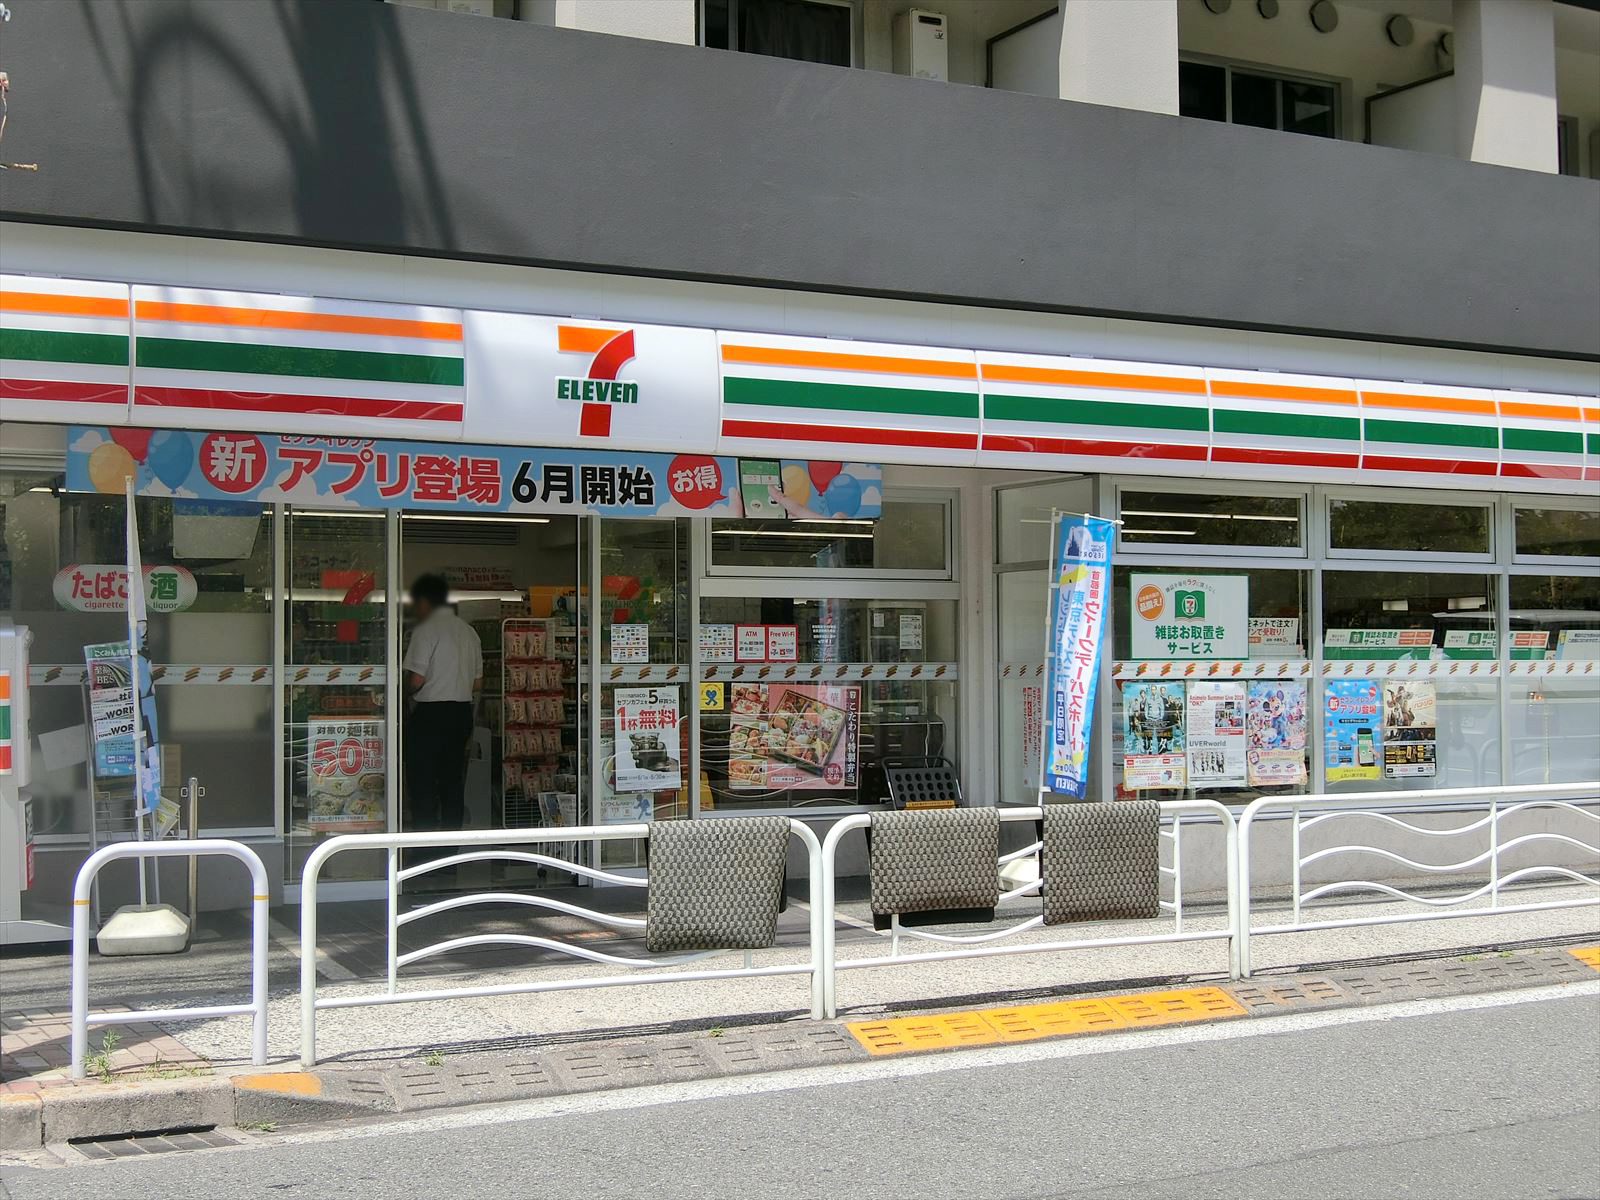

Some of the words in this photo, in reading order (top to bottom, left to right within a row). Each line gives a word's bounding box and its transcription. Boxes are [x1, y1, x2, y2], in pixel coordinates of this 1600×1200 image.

[557, 325, 635, 437] 7
[209, 436, 257, 483] 新
[672, 465, 719, 493] お得
[150, 572, 178, 600] 酒
[84, 600, 125, 609] cigarette
[152, 601, 178, 610] liquor
[1155, 625, 1225, 640] 雑誌お取置き
[1249, 628, 1286, 636] ンで受取り!
[1167, 641, 1213, 655] サービス
[847, 702, 858, 784] こだわり特製弁当
